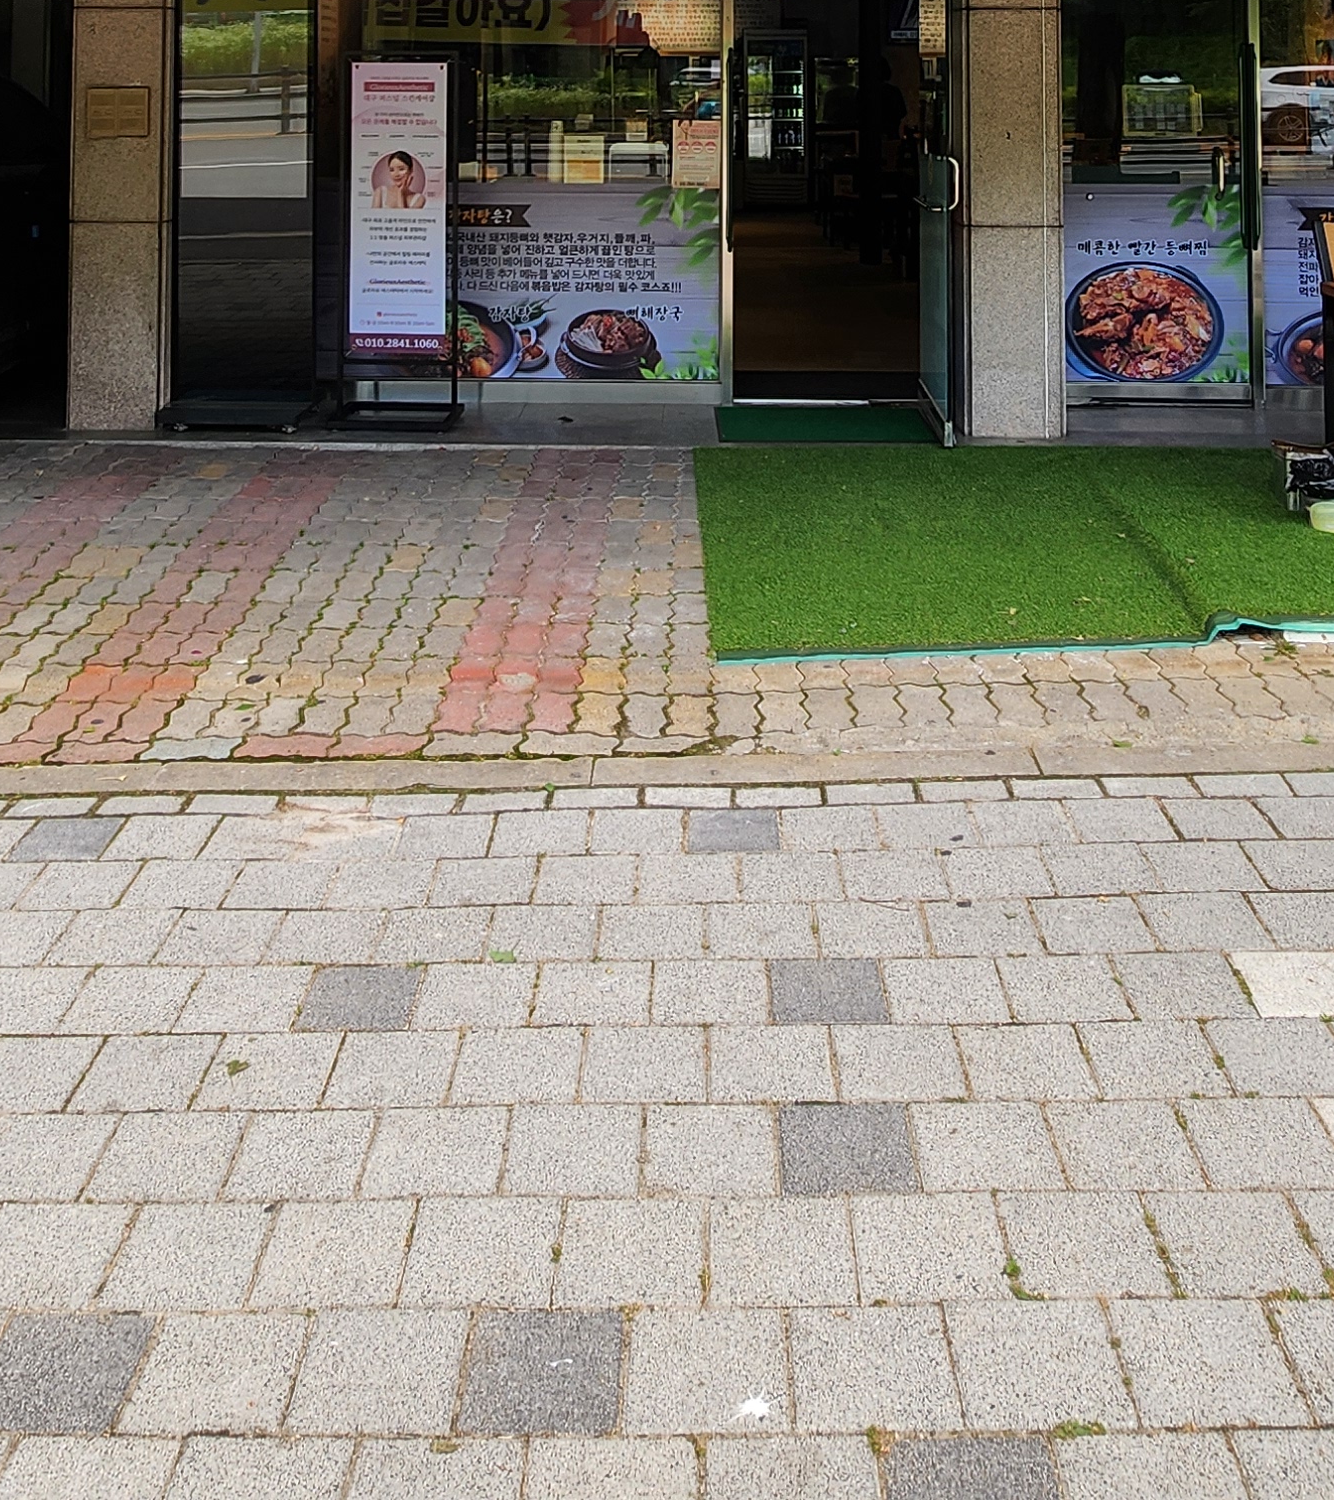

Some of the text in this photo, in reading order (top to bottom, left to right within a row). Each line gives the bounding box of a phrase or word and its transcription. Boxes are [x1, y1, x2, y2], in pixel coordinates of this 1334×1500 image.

[457, 232, 486, 243] 국내산
[489, 232, 539, 243] 돼지등뼈와
[467, 244, 498, 256] 양념을
[501, 244, 522, 256] 넣어
[525, 244, 556, 256] 진하고
[558, 244, 599, 256] 얼큰하게
[601, 245, 622, 256] 끓인
[624, 245, 656, 256] 탕으로
[1077, 239, 1210, 256] 매콤한 빨간 등뼈찜
[545, 257, 564, 268] 깊고
[565, 257, 595, 268] 구수한
[596, 257, 616, 268] 맛을
[464, 268, 484, 279] 사리
[486, 269, 496, 280] 등
[497, 268, 517, 280] 추가
[519, 268, 548, 280] 메뉴를
[550, 269, 570, 280] 넣어
[571, 269, 600, 280] 드시면
[603, 269, 622, 280] 더욱
[624, 269, 656, 281] 맛있게
[478, 281, 498, 292] 드신
[500, 281, 530, 292] 다음에
[574, 281, 615, 293] 감자탕의
[618, 282, 639, 293] 필수
[488, 306, 533, 323] 감자탕
[624, 305, 684, 322] 뼈해장국
[365, 338, 439, 349] 010.2841.1060
